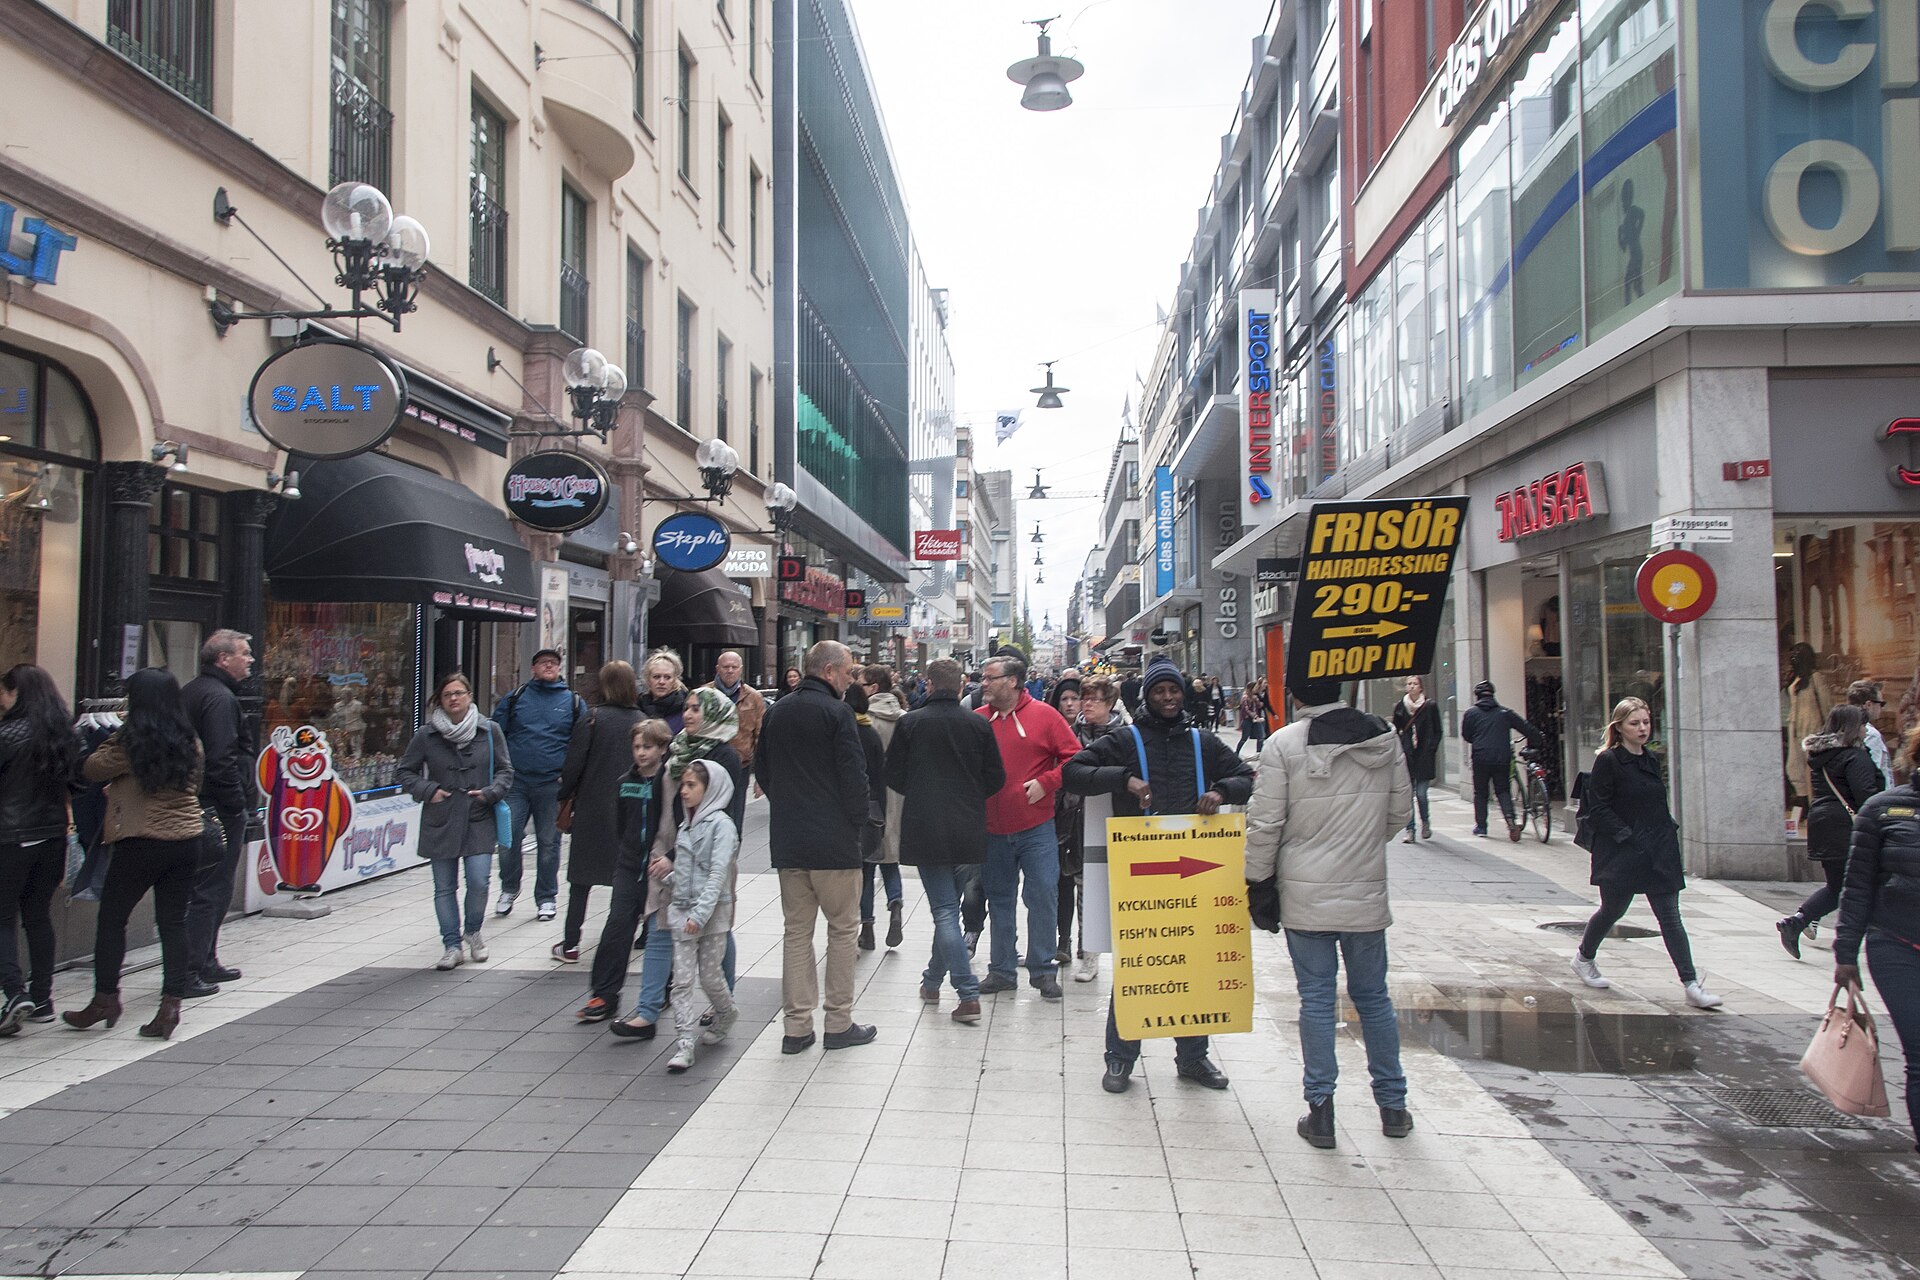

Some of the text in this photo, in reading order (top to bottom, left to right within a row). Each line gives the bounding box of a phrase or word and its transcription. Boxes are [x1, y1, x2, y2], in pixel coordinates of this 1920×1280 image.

[1434, 26, 1481, 128] clas
[271, 385, 380, 412] SALT
[1249, 309, 1272, 472] INTERSPORT
[1746, 465, 1765, 475] 0,5
[1158, 490, 1173, 572] clas ohlson
[1310, 501, 1460, 554] FRISÖR
[656, 529, 706, 555] Step
[727, 550, 767, 561] VERO
[724, 561, 769, 572] MODA
[782, 561, 801, 578] D
[1258, 571, 1300, 580] stadium
[1306, 552, 1449, 581] HAIRDRESSING
[848, 592, 862, 605] D
[1312, 581, 1430, 618] 290:-
[1215, 587, 1238, 639] clas
[1308, 642, 1417, 679] DROP IN
[294, 834, 320, 842] GLACE
[1112, 827, 1242, 843] Restaurant London
[1118, 895, 1243, 912] KYCKLINGFILÉ 108:-
[1161, 925, 1195, 938] CHIPS
[1215, 923, 1245, 935] 108:-
[1120, 951, 1246, 969] FILÉ OSCAR 118:-
[1121, 979, 1248, 997] ENTRECÔTE 125:-
[1141, 1011, 1231, 1028] A LA CARTE
